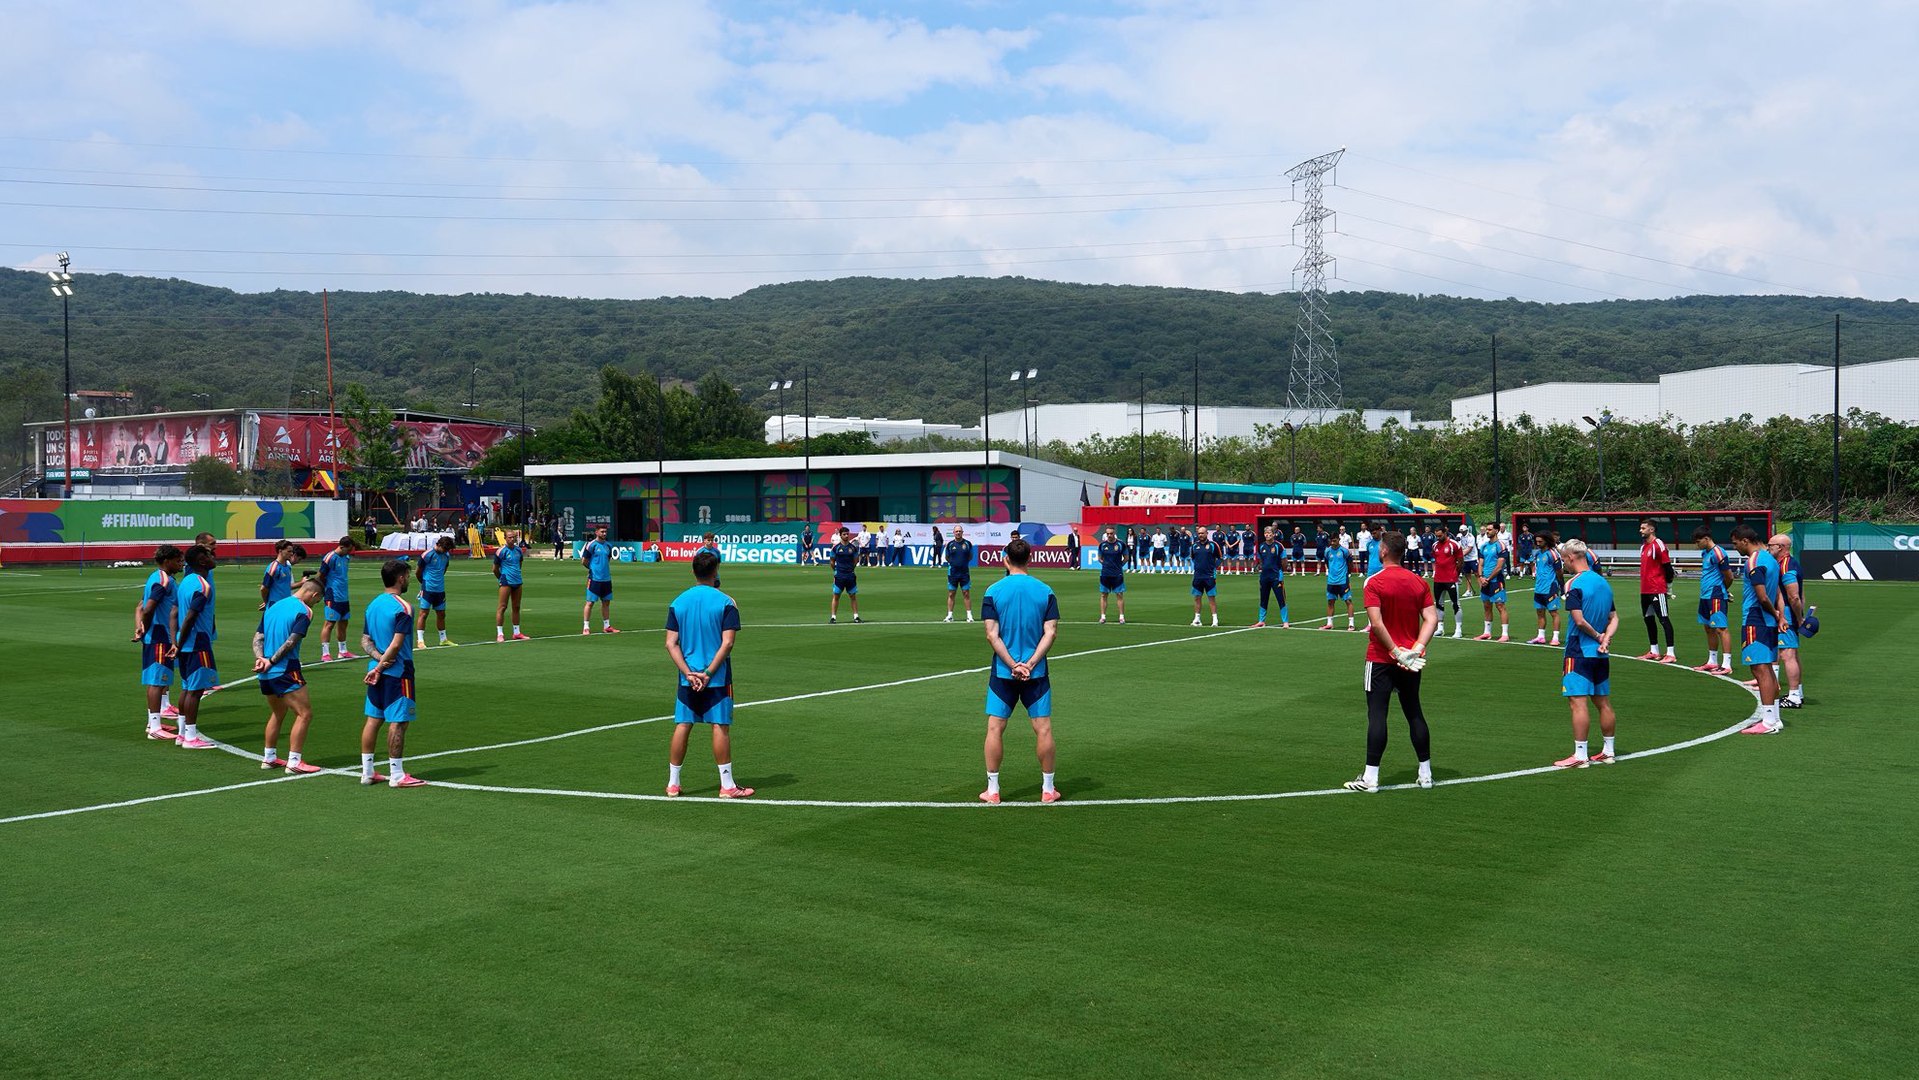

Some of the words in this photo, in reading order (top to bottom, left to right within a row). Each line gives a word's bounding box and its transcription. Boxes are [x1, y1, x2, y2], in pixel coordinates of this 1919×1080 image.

[46, 443, 57, 453] UN
[267, 446, 301, 454] SPORTS
[46, 455, 66, 466] LUGA
[268, 453, 301, 462] ARENA
[101, 513, 195, 530] #FIFAWorldCup
[683, 535, 706, 544] FIFA
[713, 535, 740, 544] ORLD
[741, 535, 762, 544] CUP
[763, 534, 798, 544] 2026
[716, 544, 798, 563] Hisense
[1030, 550, 1073, 563] AIRWAY
